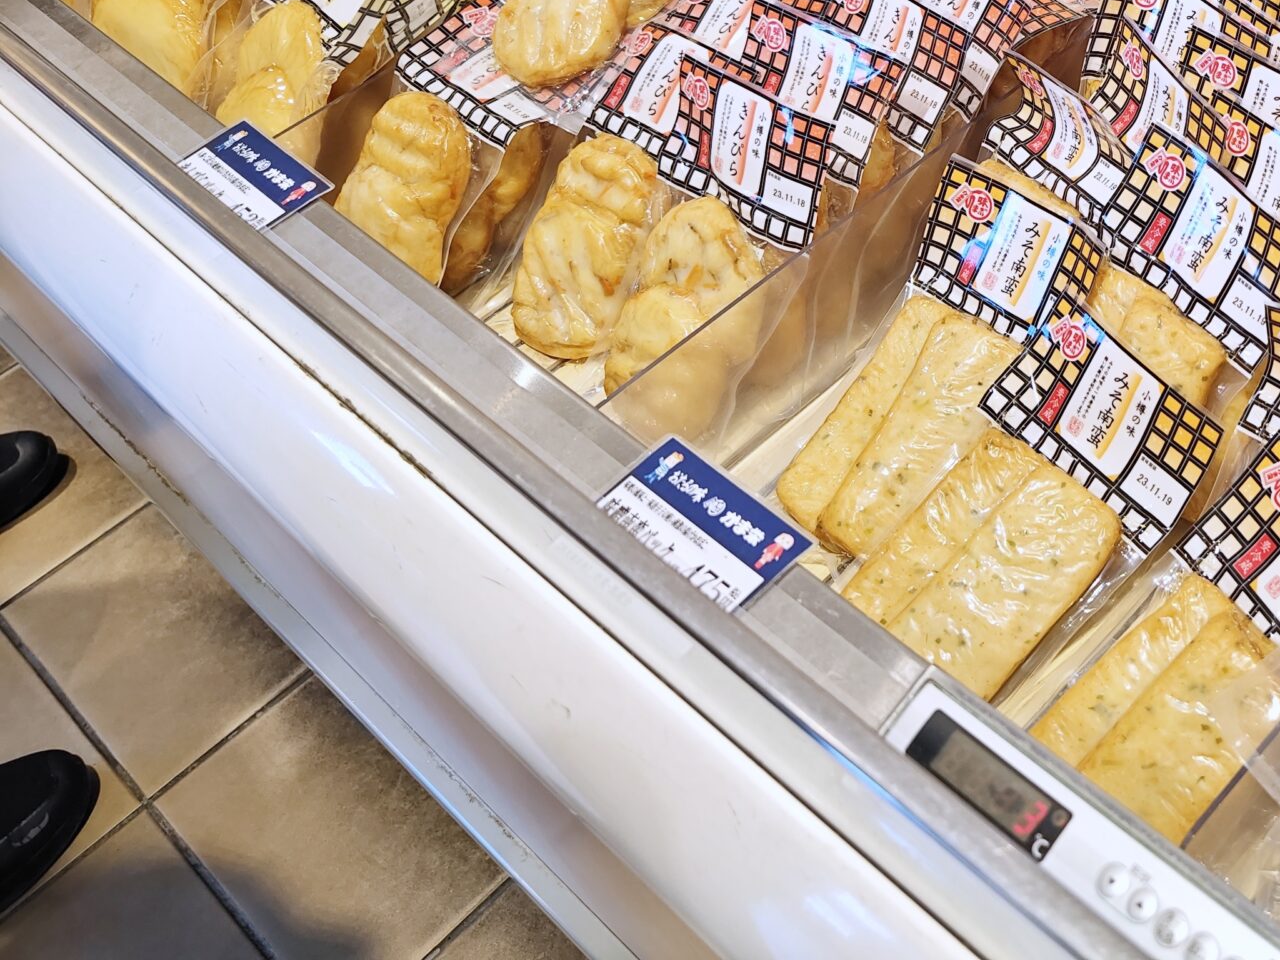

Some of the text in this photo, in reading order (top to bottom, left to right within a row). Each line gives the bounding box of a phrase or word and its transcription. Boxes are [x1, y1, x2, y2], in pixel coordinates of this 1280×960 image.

[910, 88, 938, 109] 23.11.18
[730, 102, 750, 176] きんぴら
[752, 112, 767, 159] 小樽の味
[843, 126, 868, 144] 23.11.18
[773, 189, 805, 207] 23.11.18
[1037, 234, 1061, 281] 小樽の味
[1186, 196, 1229, 274] みそ南蛮
[1222, 214, 1246, 260] 小樽の味
[1001, 222, 1041, 297] みそ南蛮
[1232, 297, 1266, 326] 23.11.19
[1087, 373, 1130, 448] みそ南蛮
[1126, 391, 1151, 438] 小樽の味
[1136, 474, 1172, 506] 23.11.19
[1237, 540, 1273, 574] 要冷蔵
